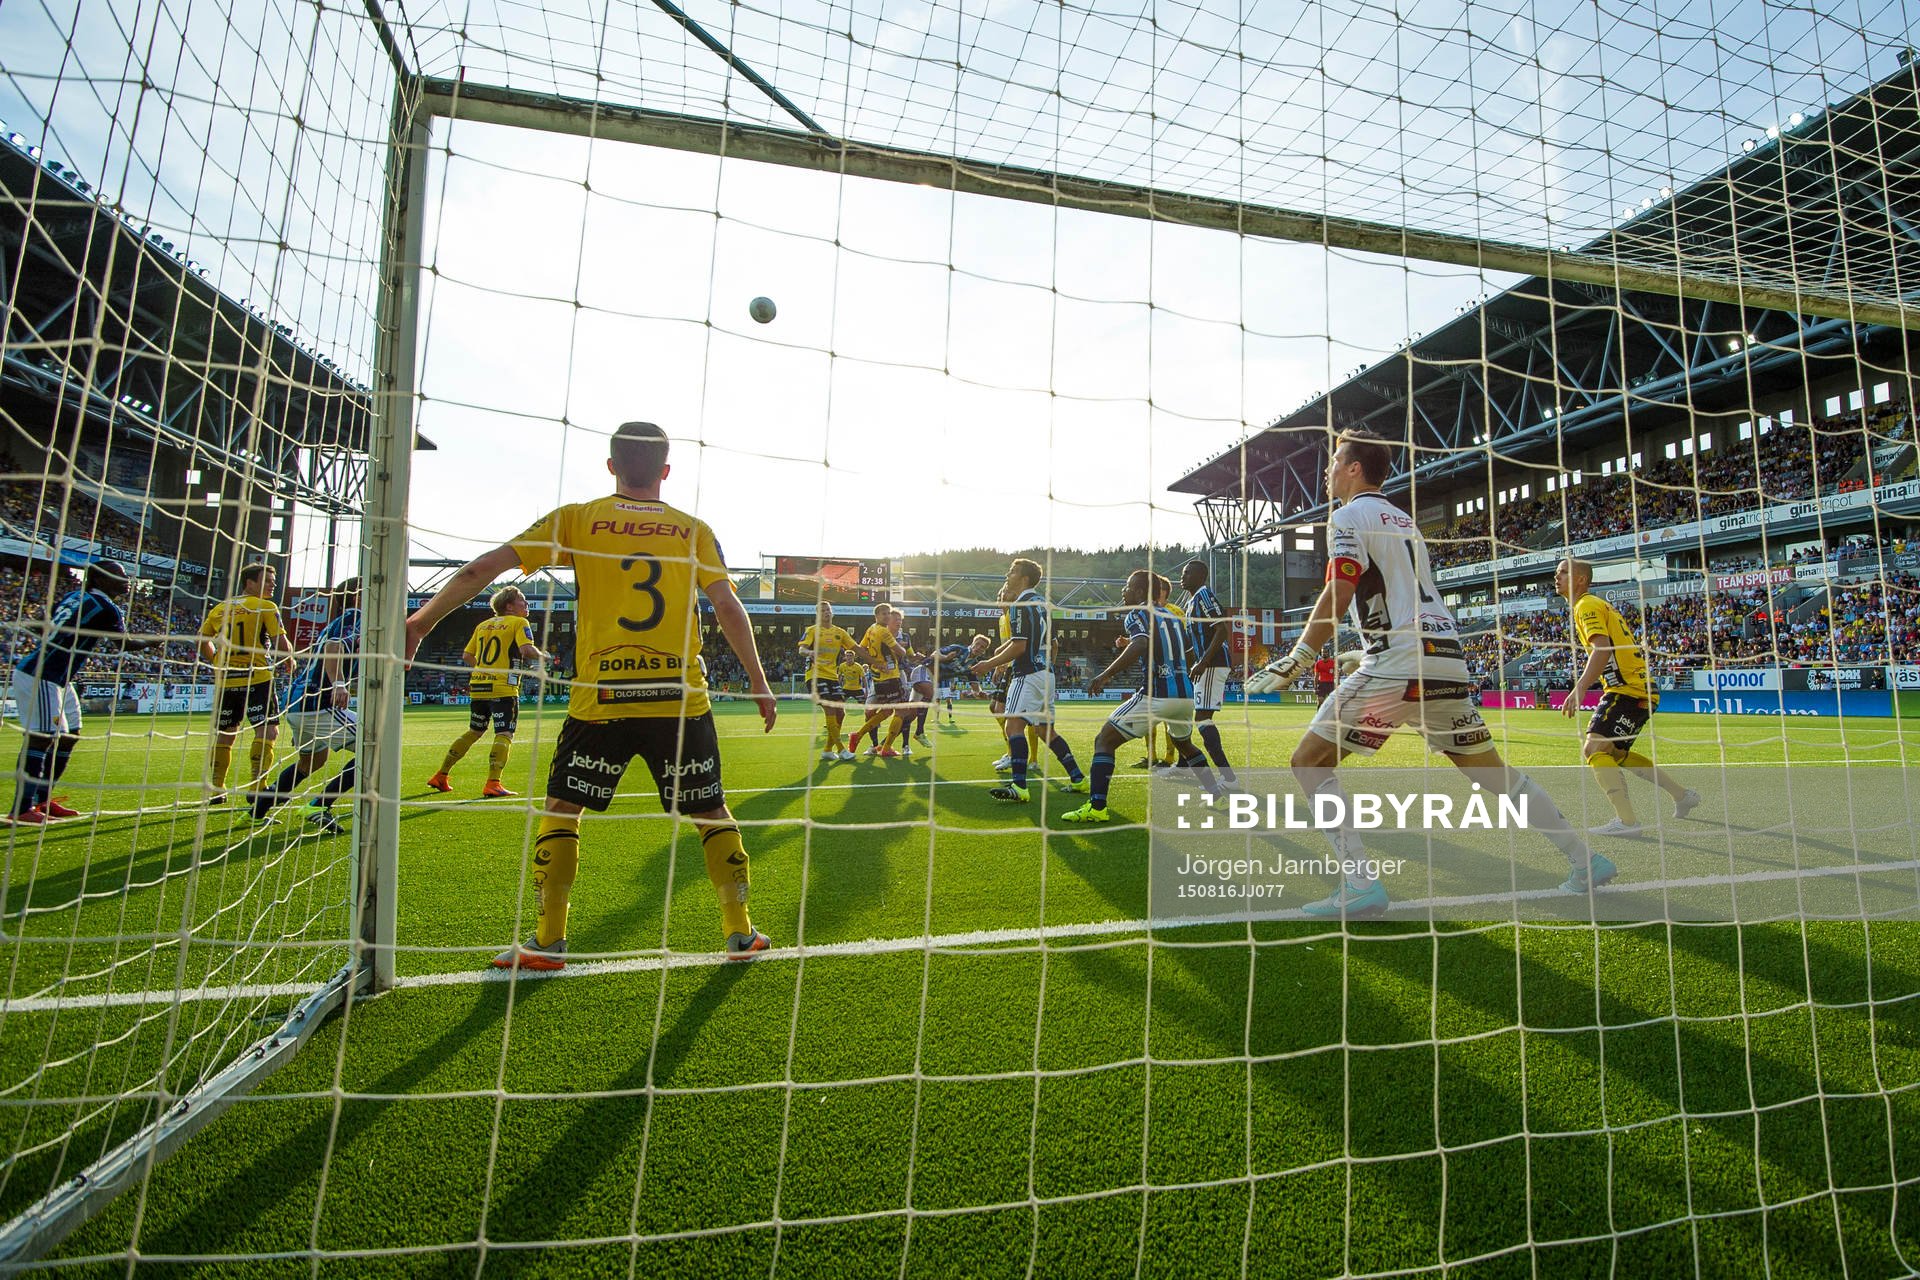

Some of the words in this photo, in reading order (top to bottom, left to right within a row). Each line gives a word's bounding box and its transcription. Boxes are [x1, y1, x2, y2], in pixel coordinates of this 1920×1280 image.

[1873, 479, 1920, 503] ginatri
[1719, 508, 1774, 531] ginatricot
[591, 520, 691, 539] PULSEN
[863, 566, 868, 574] 2
[877, 567, 883, 575] 0
[861, 577, 884, 585] 87:38
[1717, 575, 1745, 589] TEAM
[617, 552, 666, 633] 3
[1160, 620, 1186, 662] 11
[476, 635, 502, 667] 10
[600, 655, 661, 672] BORÅS
[1707, 671, 1766, 690] uponor
[1889, 669, 1920, 683] väs
[616, 689, 659, 698] OLOFSSON
[1456, 729, 1490, 745] Cerne
[567, 775, 615, 799] Cerne
